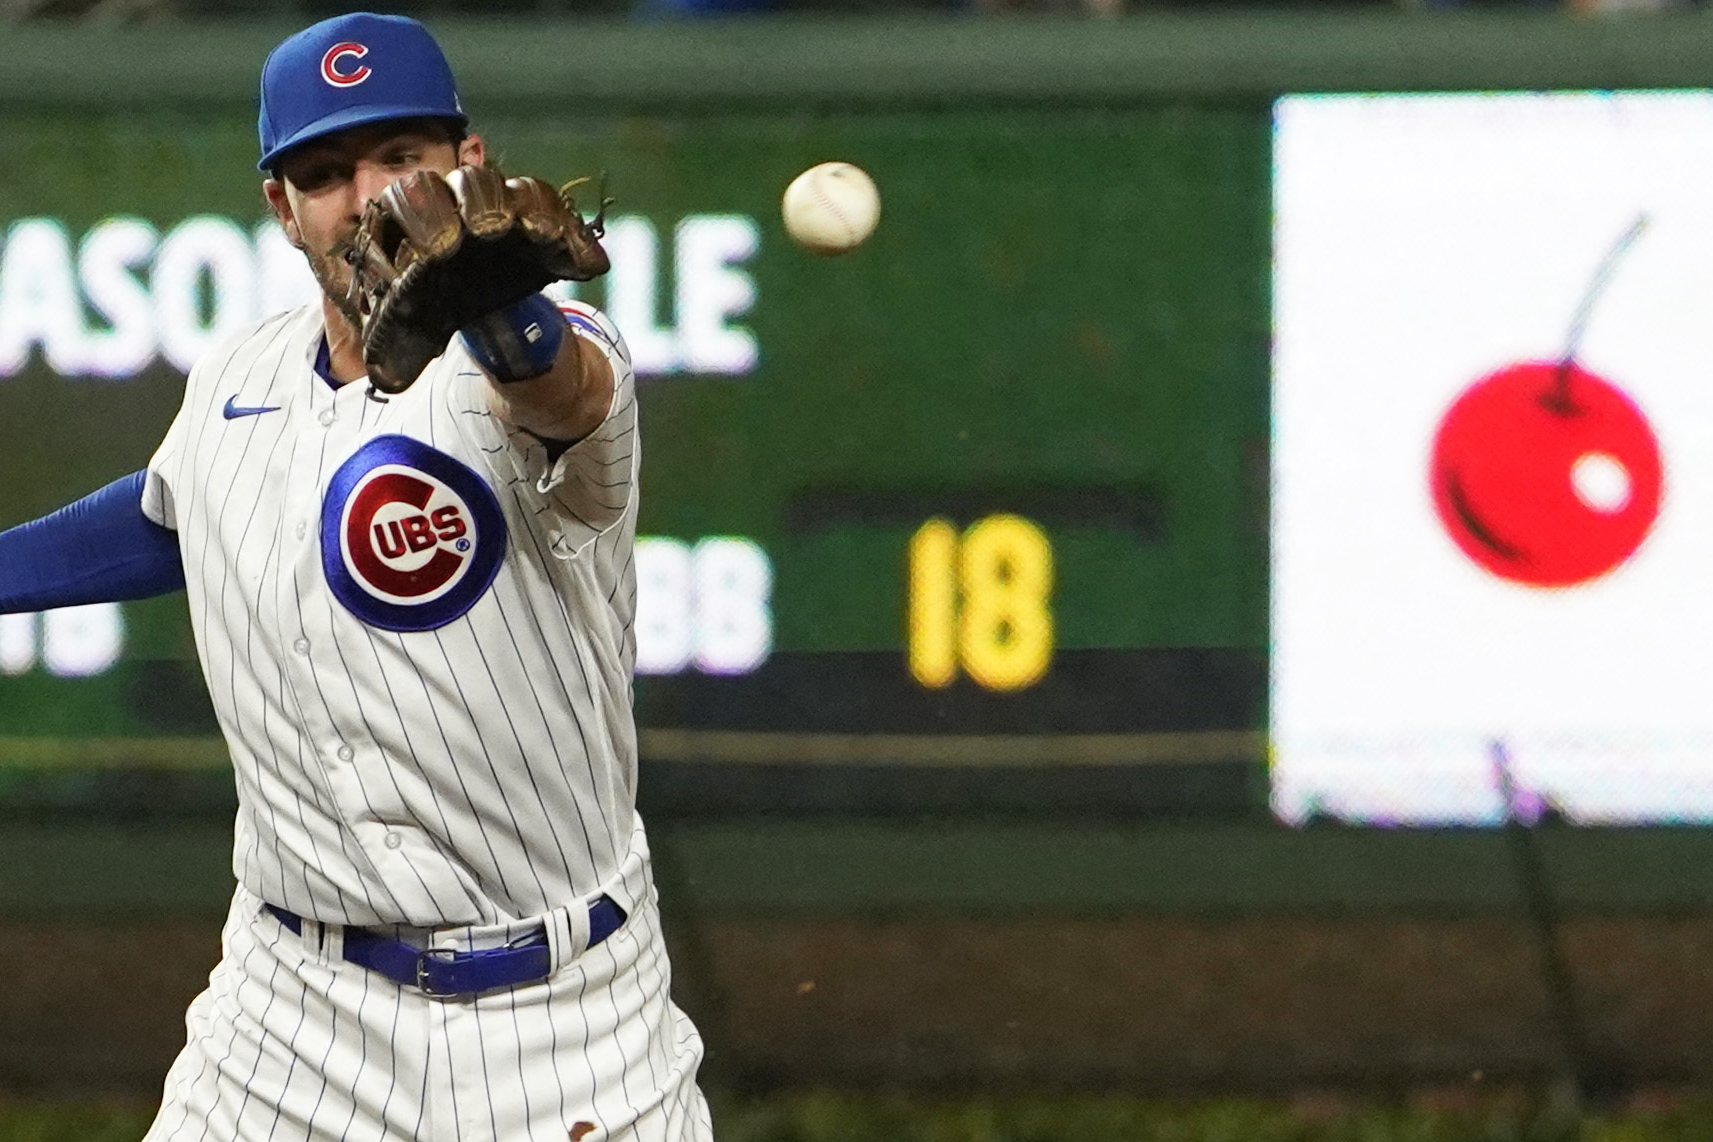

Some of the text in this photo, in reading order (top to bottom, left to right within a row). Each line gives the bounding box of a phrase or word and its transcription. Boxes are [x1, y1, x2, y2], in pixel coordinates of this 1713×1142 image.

[320, 41, 373, 88] C
[346, 472, 467, 598] CUBS
[908, 514, 1055, 690] 18
